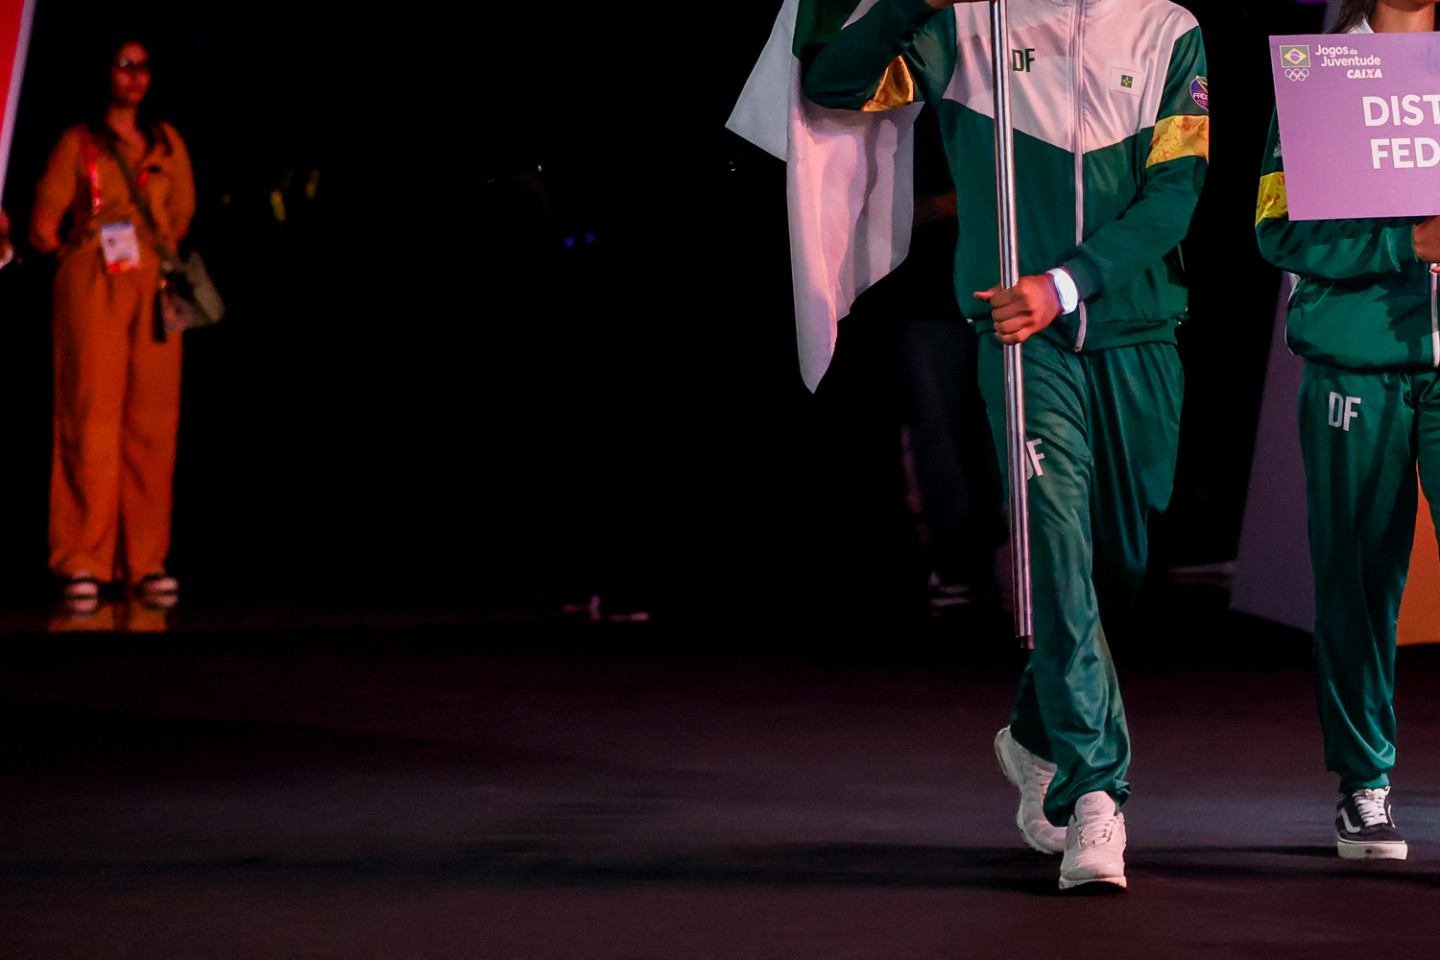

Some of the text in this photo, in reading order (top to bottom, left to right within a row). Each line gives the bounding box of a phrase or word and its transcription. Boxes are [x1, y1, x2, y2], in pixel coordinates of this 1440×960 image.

[1315, 44, 1349, 58] Jogos
[1011, 48, 1035, 72] DF
[1321, 55, 1381, 67] Juventude
[1347, 69, 1383, 79] CAIXA
[1328, 391, 1361, 432] DF
